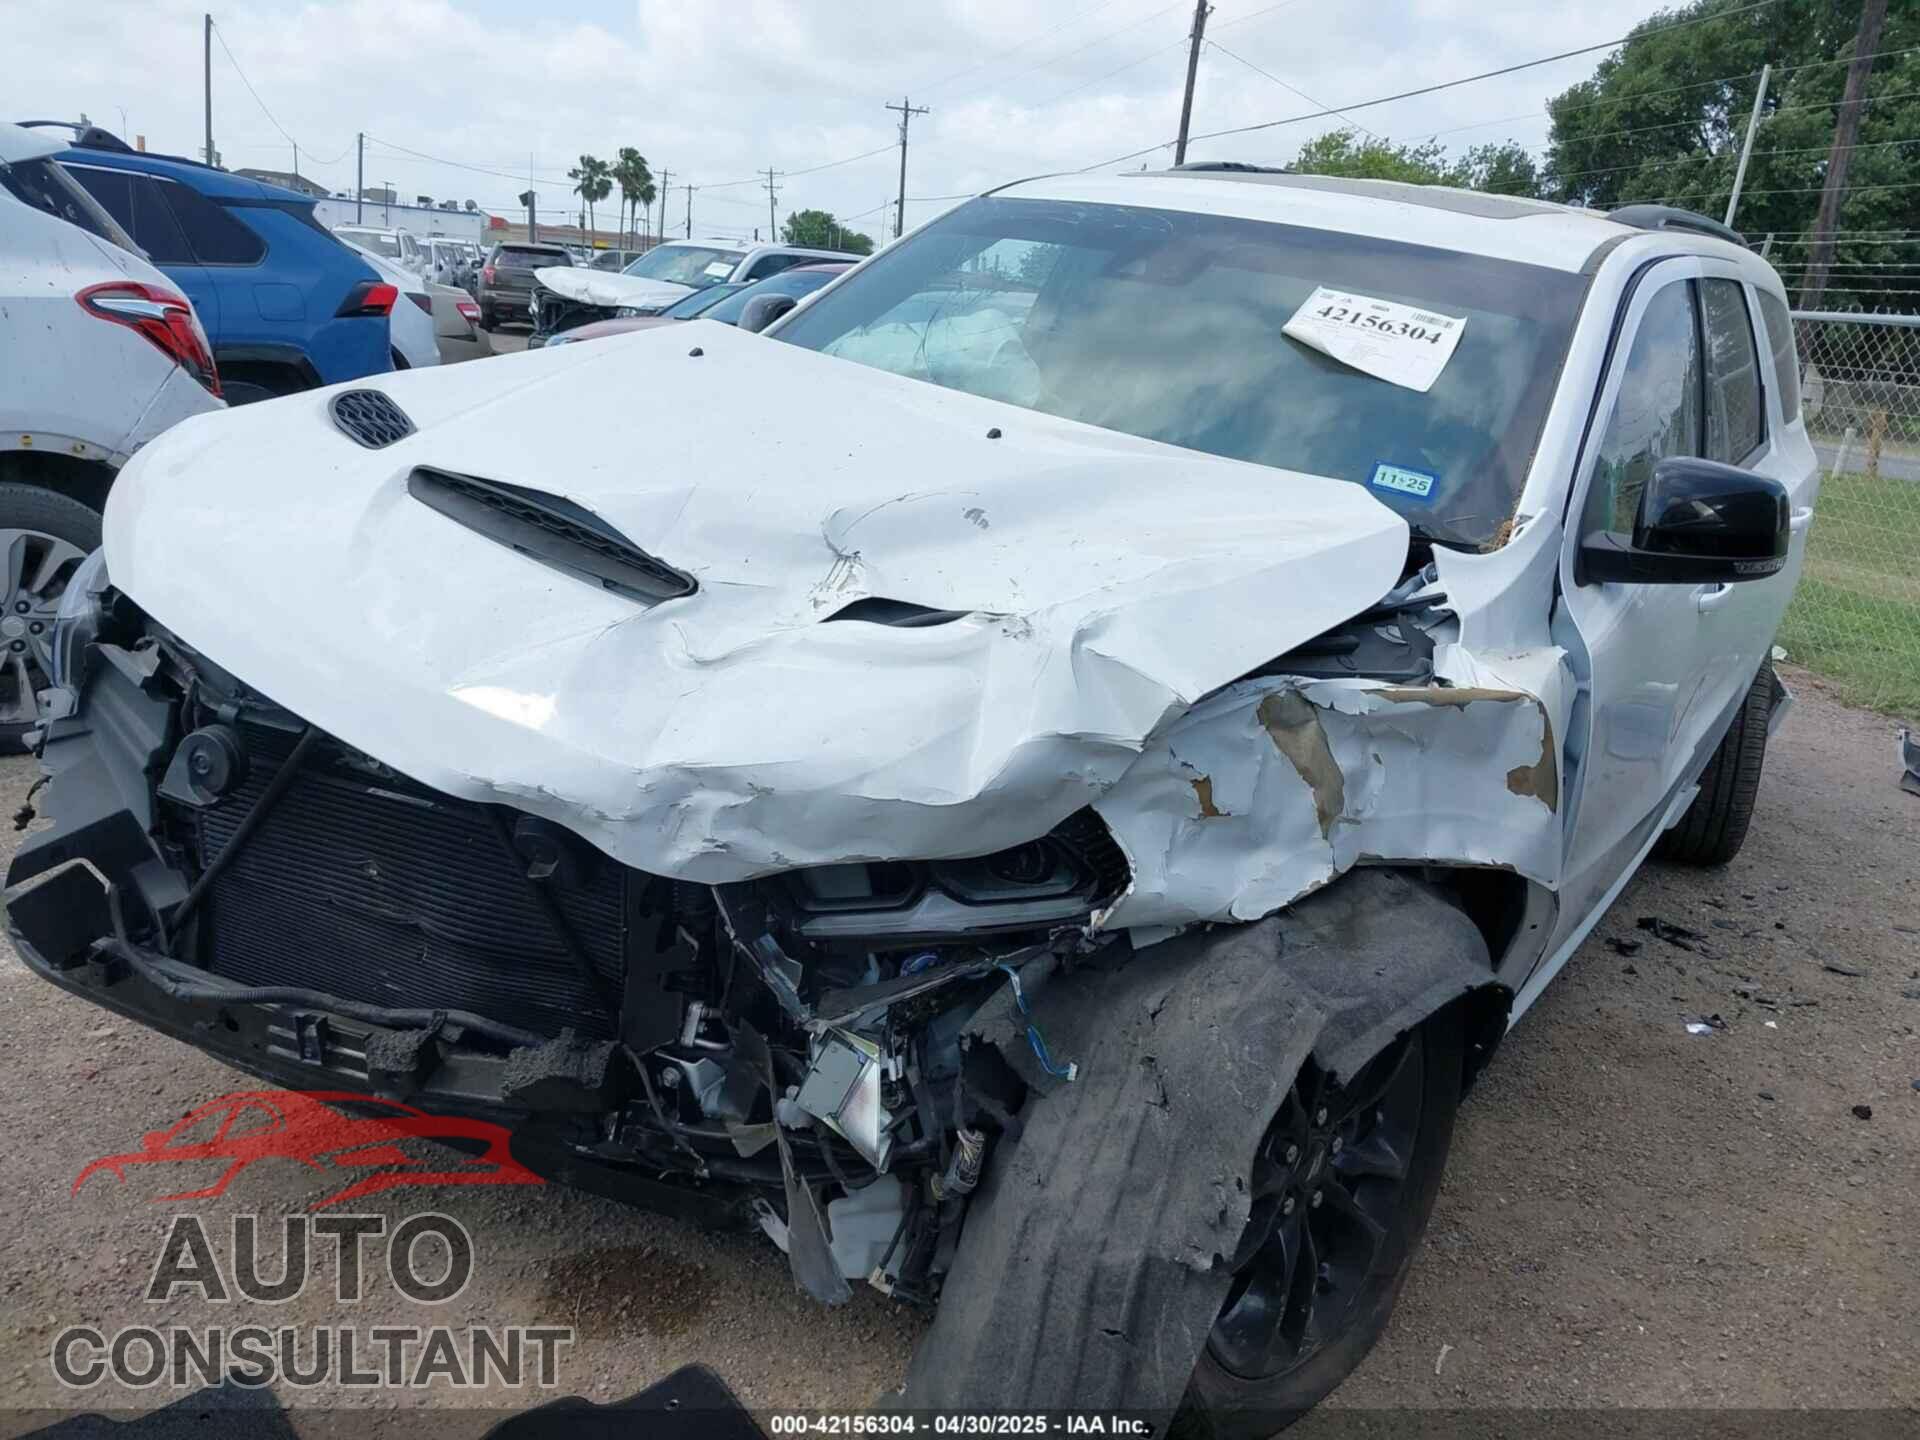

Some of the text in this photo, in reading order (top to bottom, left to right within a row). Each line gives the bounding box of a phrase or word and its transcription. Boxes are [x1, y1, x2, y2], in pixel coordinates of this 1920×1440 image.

[1317, 305, 1442, 345] 42156304
[1380, 472, 1429, 491] 11 25
